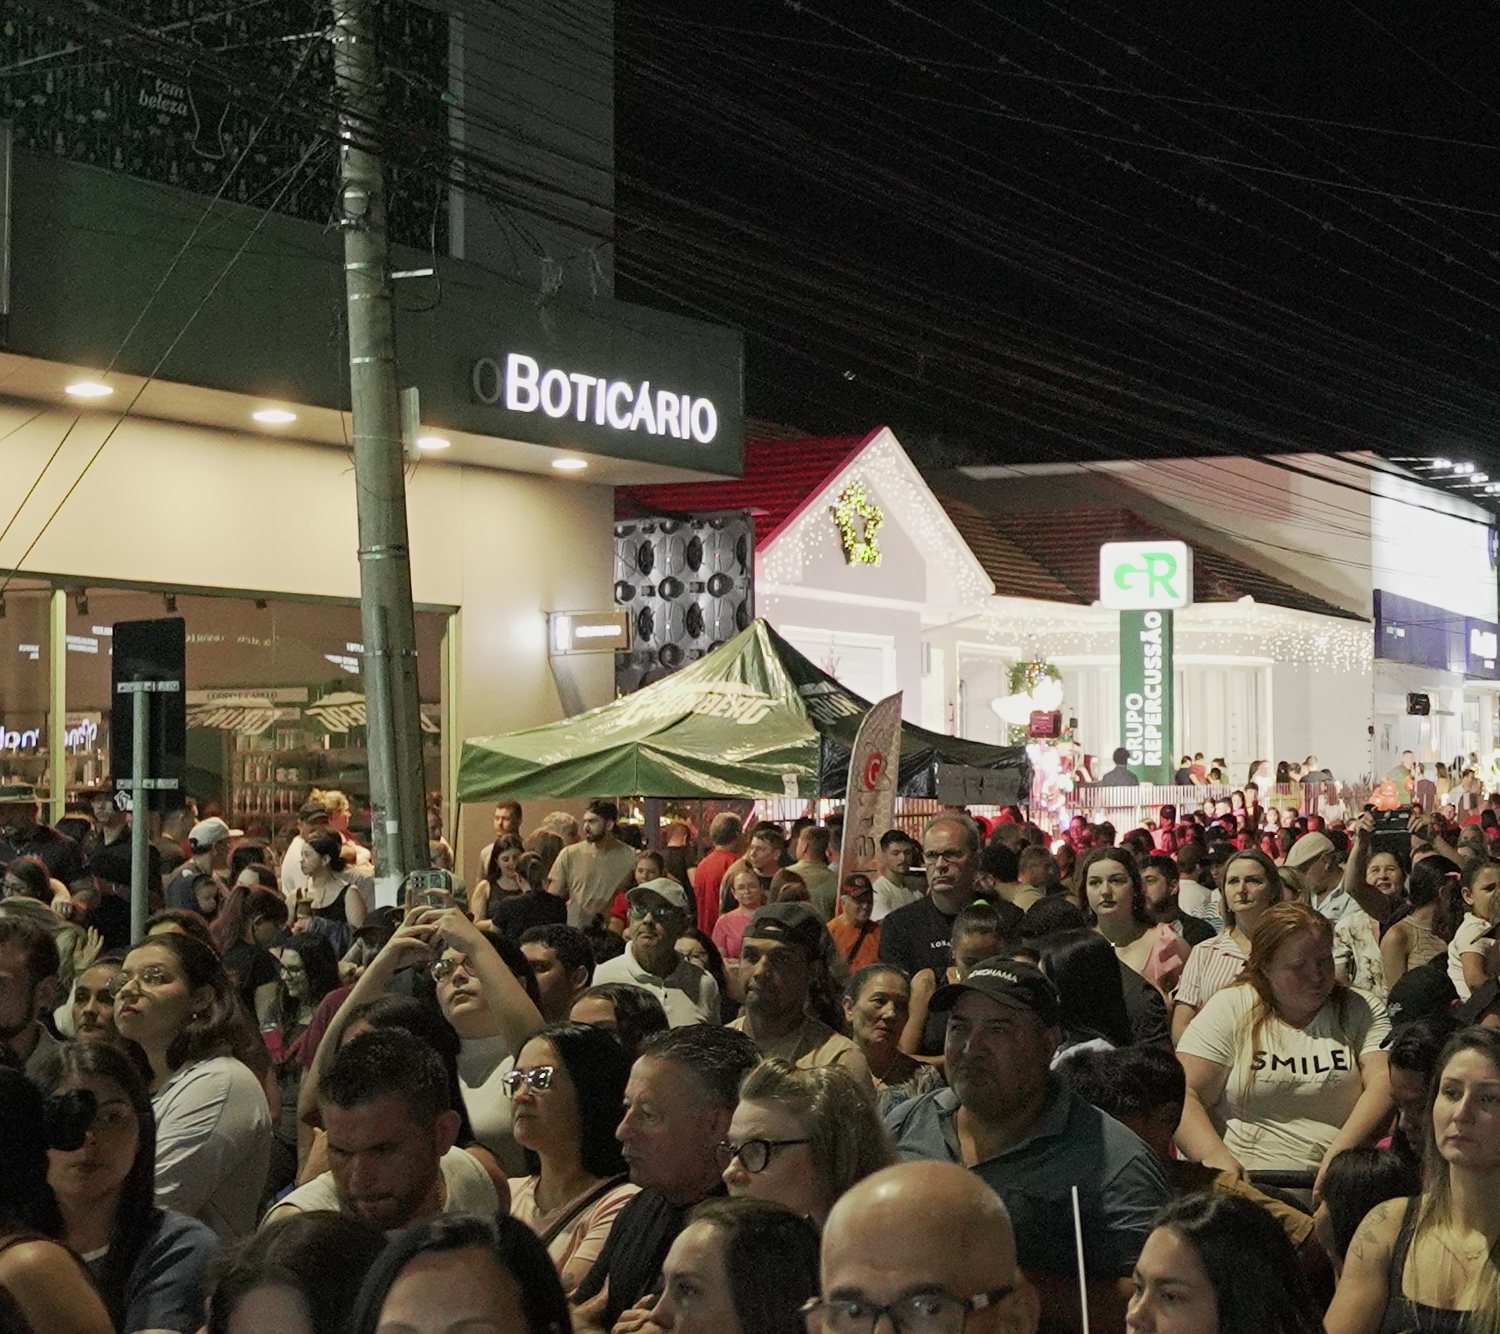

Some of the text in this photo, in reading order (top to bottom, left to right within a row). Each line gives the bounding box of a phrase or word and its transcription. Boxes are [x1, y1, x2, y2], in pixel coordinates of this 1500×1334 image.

[1140, 611, 1163, 767] REPERCUSSÃO
[1125, 693, 1144, 767] GRUPO
[1251, 1049, 1349, 1074] SMILE
